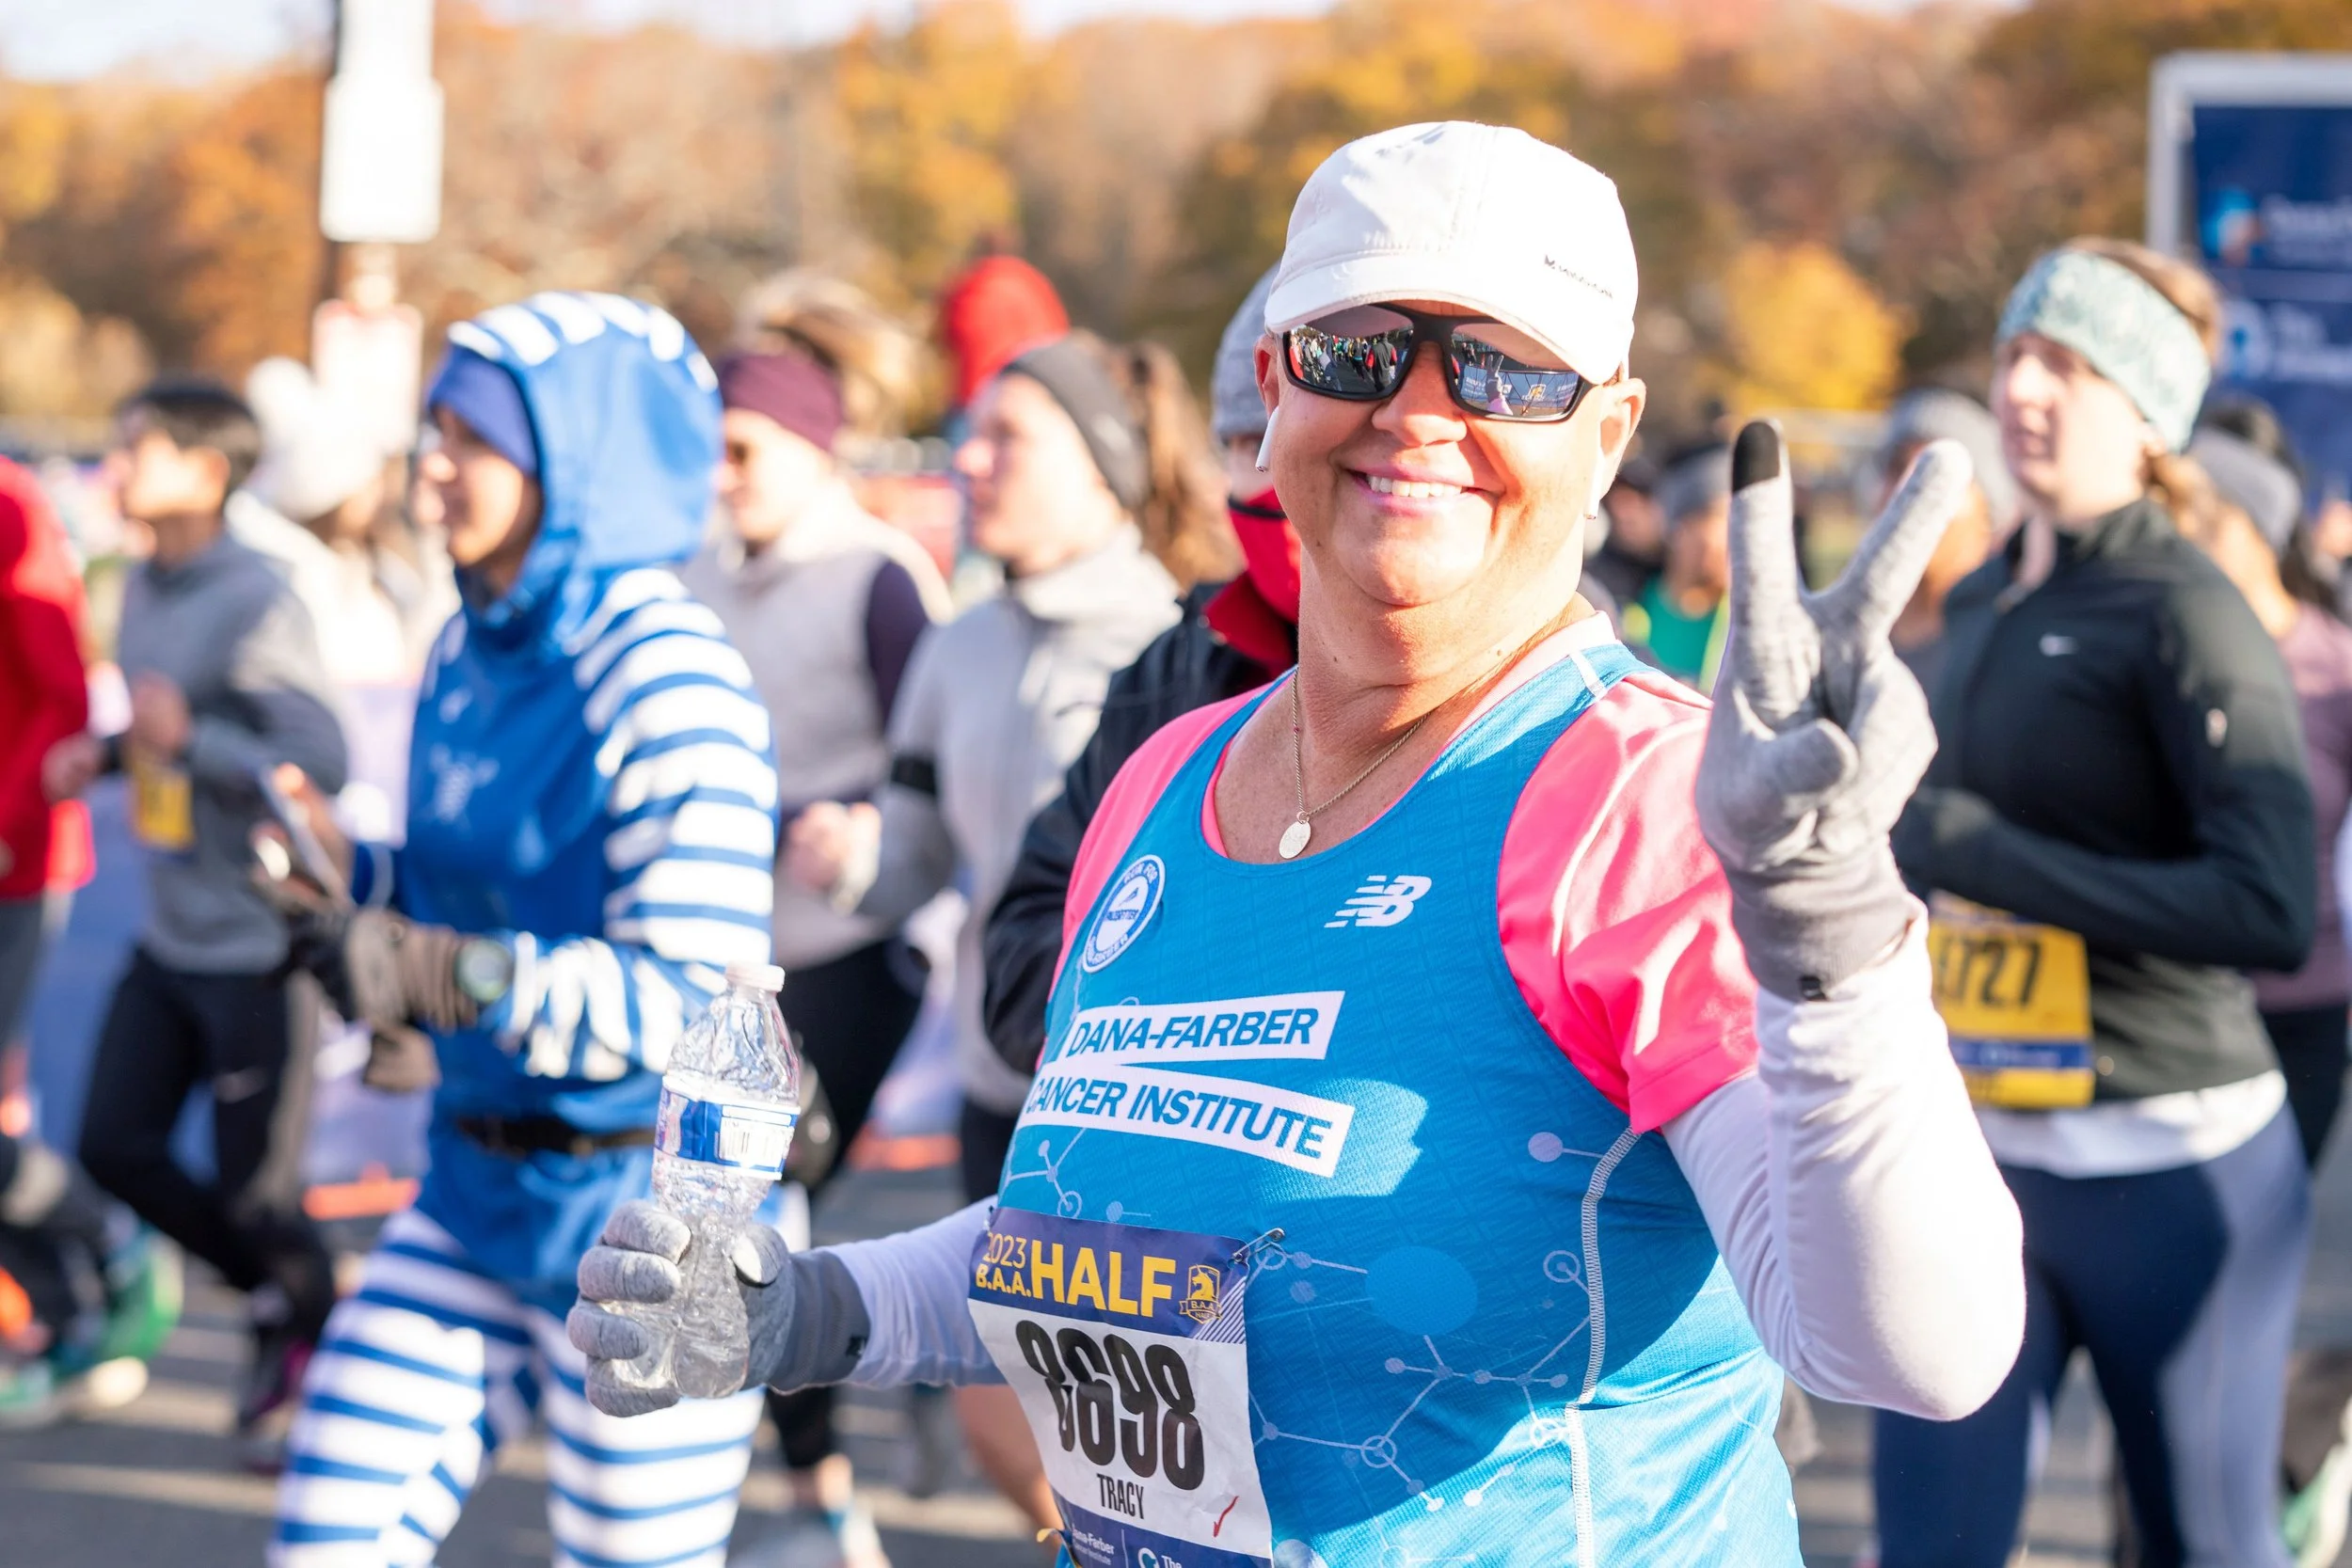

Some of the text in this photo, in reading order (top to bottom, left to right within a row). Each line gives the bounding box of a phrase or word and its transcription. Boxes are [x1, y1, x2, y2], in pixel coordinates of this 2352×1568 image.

[1066, 1007, 1319, 1058] DANA-FARBER
[1127, 1085, 1333, 1159] INSTITUTE
[976, 1239, 1176, 1317] B.A.A. HALF
[982, 1231, 1027, 1269] 2023
[1015, 1319, 1205, 1490] 8698
[1097, 1472, 1145, 1520] TRACY
